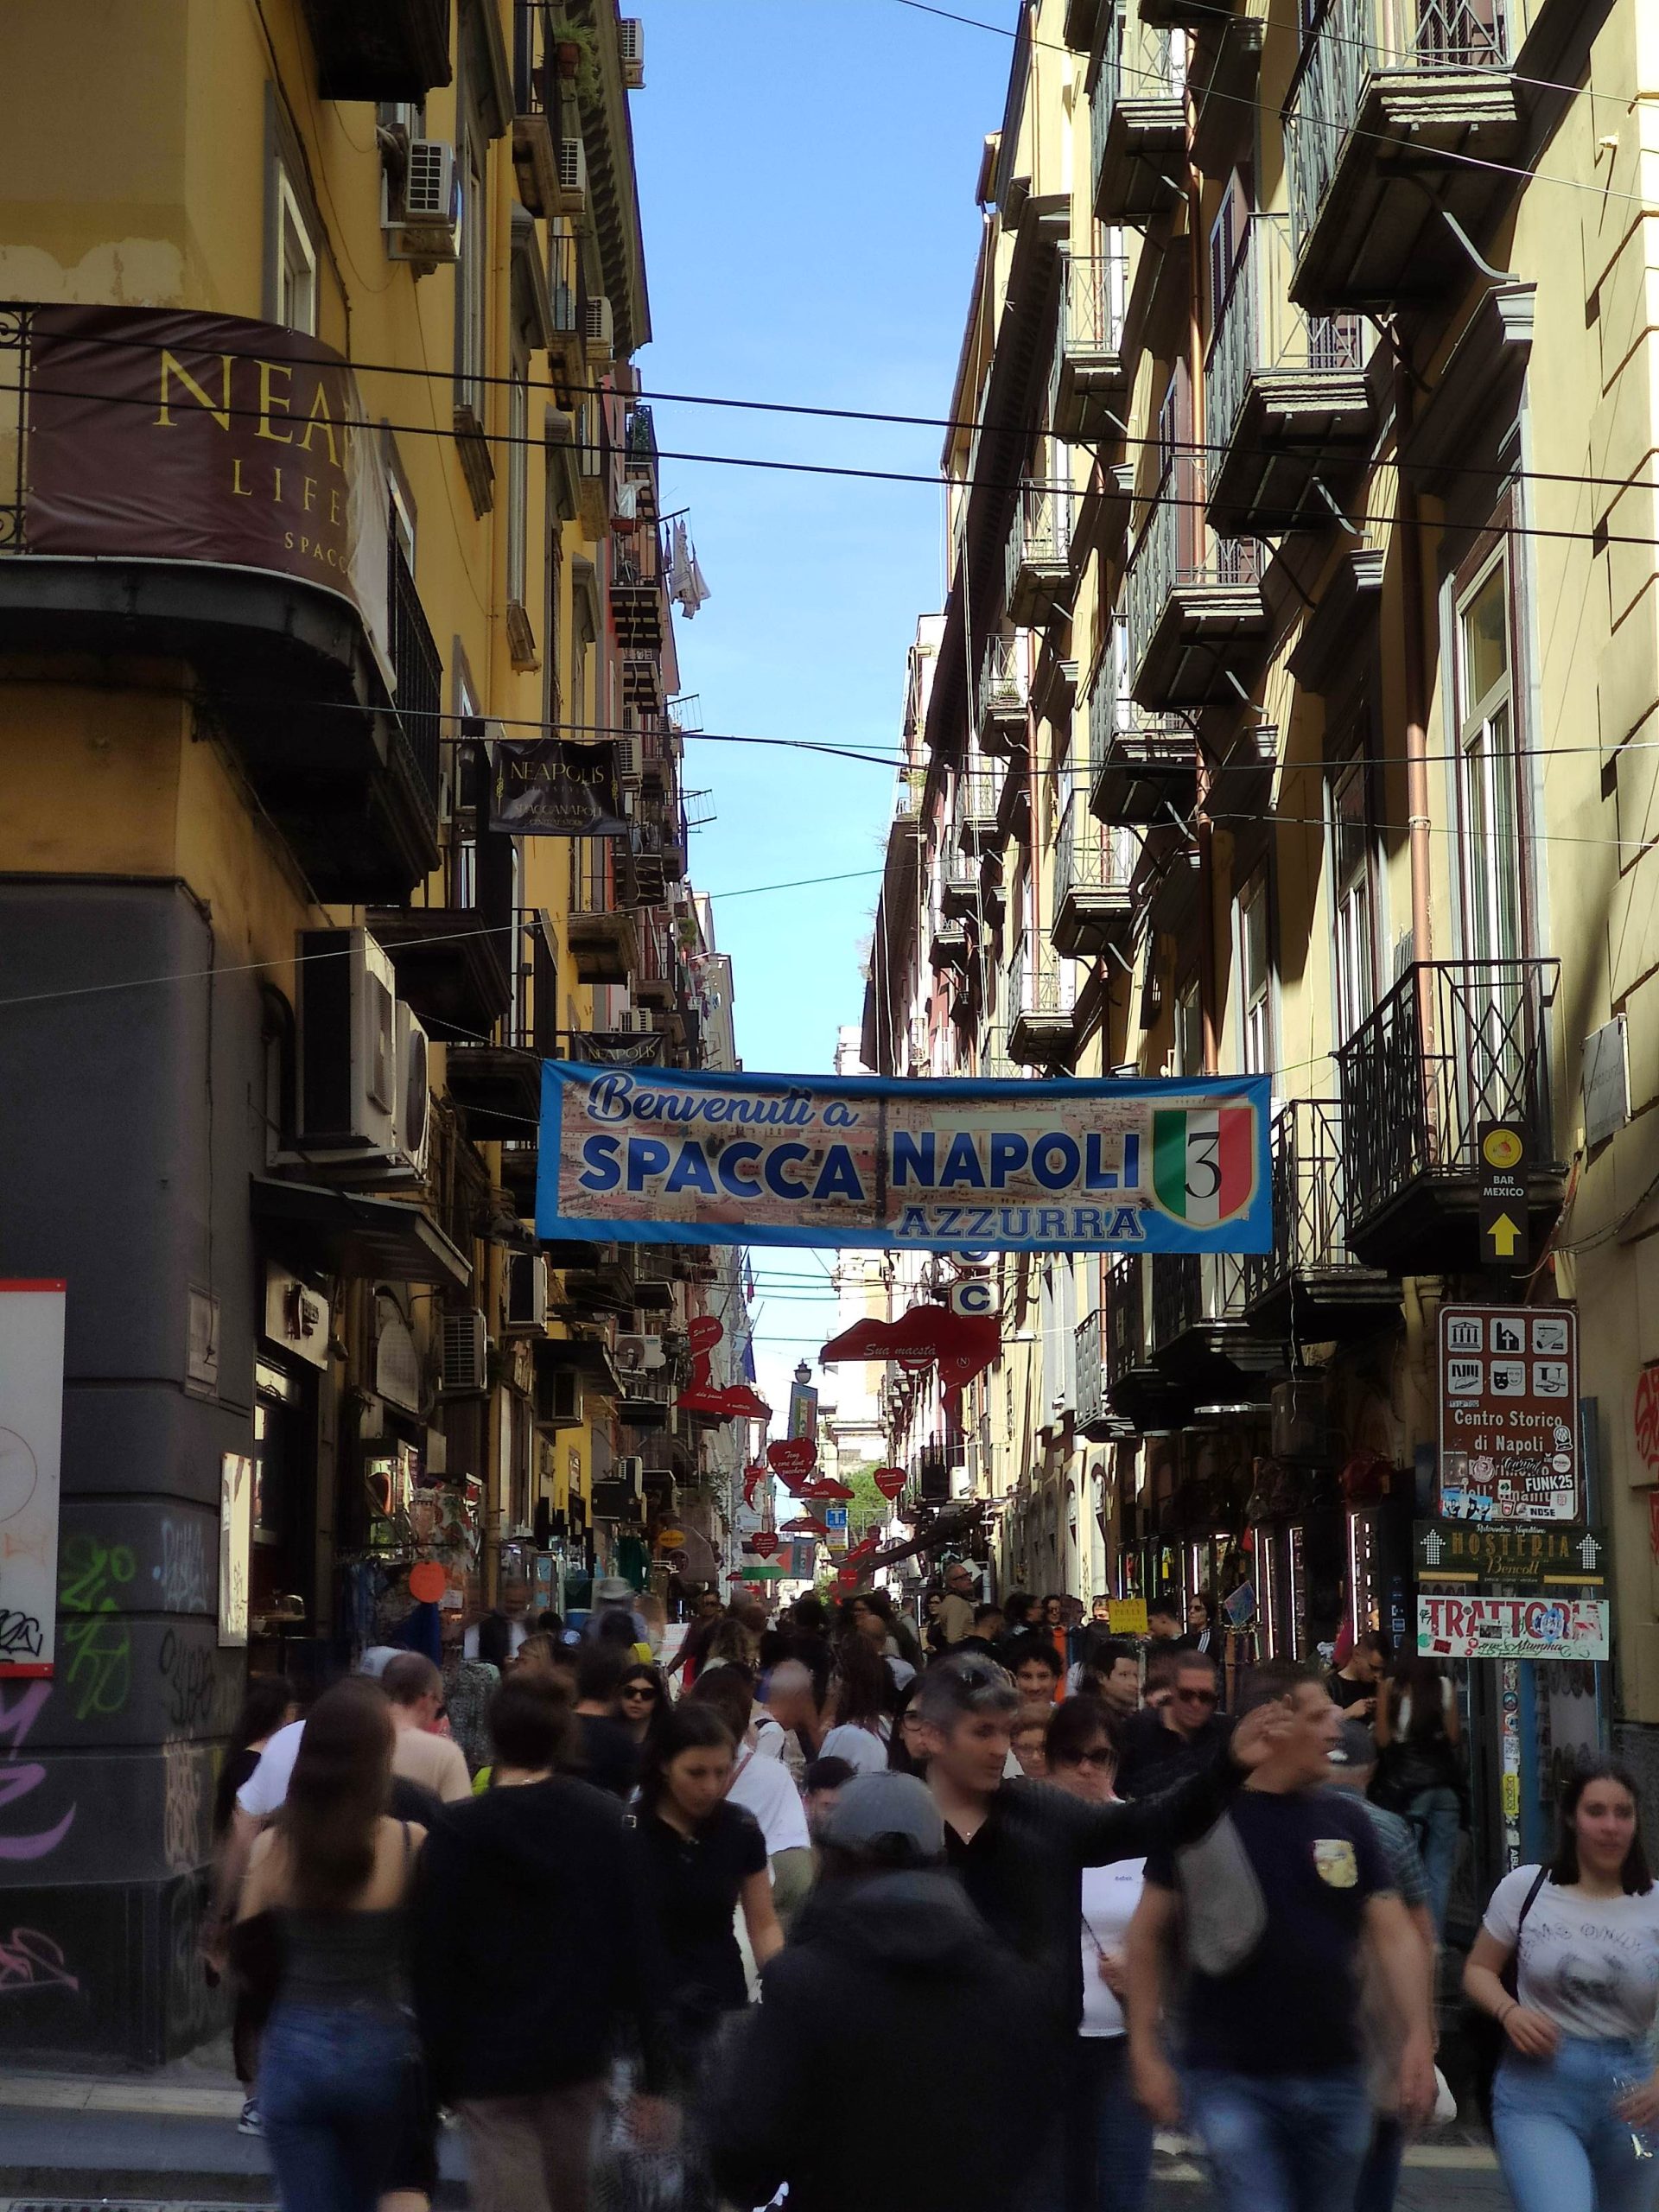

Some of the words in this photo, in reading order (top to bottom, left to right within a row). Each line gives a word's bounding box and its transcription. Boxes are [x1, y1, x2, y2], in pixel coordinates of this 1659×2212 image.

[152, 348, 350, 468] NEA
[232, 459, 340, 525] LIFE
[511, 761, 604, 784] NEAPOLIS
[588, 1072, 816, 1126] Benvenuti
[823, 1102, 859, 1127] a
[578, 1135, 866, 1200] SPACCA
[893, 1131, 1140, 1190] NAPOLI
[1185, 1131, 1223, 1198] 3
[1484, 1187, 1524, 1197] MEXICO
[1493, 1175, 1514, 1185] BAR
[897, 1205, 1145, 1239] AZZURRA
[960, 1286, 990, 1311] C
[864, 1344, 890, 1356] Sua
[1454, 1409, 1504, 1426] Centro
[1510, 1411, 1562, 1427] Storico
[1474, 1434, 1488, 1451] di
[1496, 1435, 1543, 1455] Napoli
[1525, 1474, 1573, 1491] FUNK25
[1452, 1532, 1570, 1558] HOSTERIA
[1426, 1599, 1603, 1641] TRATTOR
